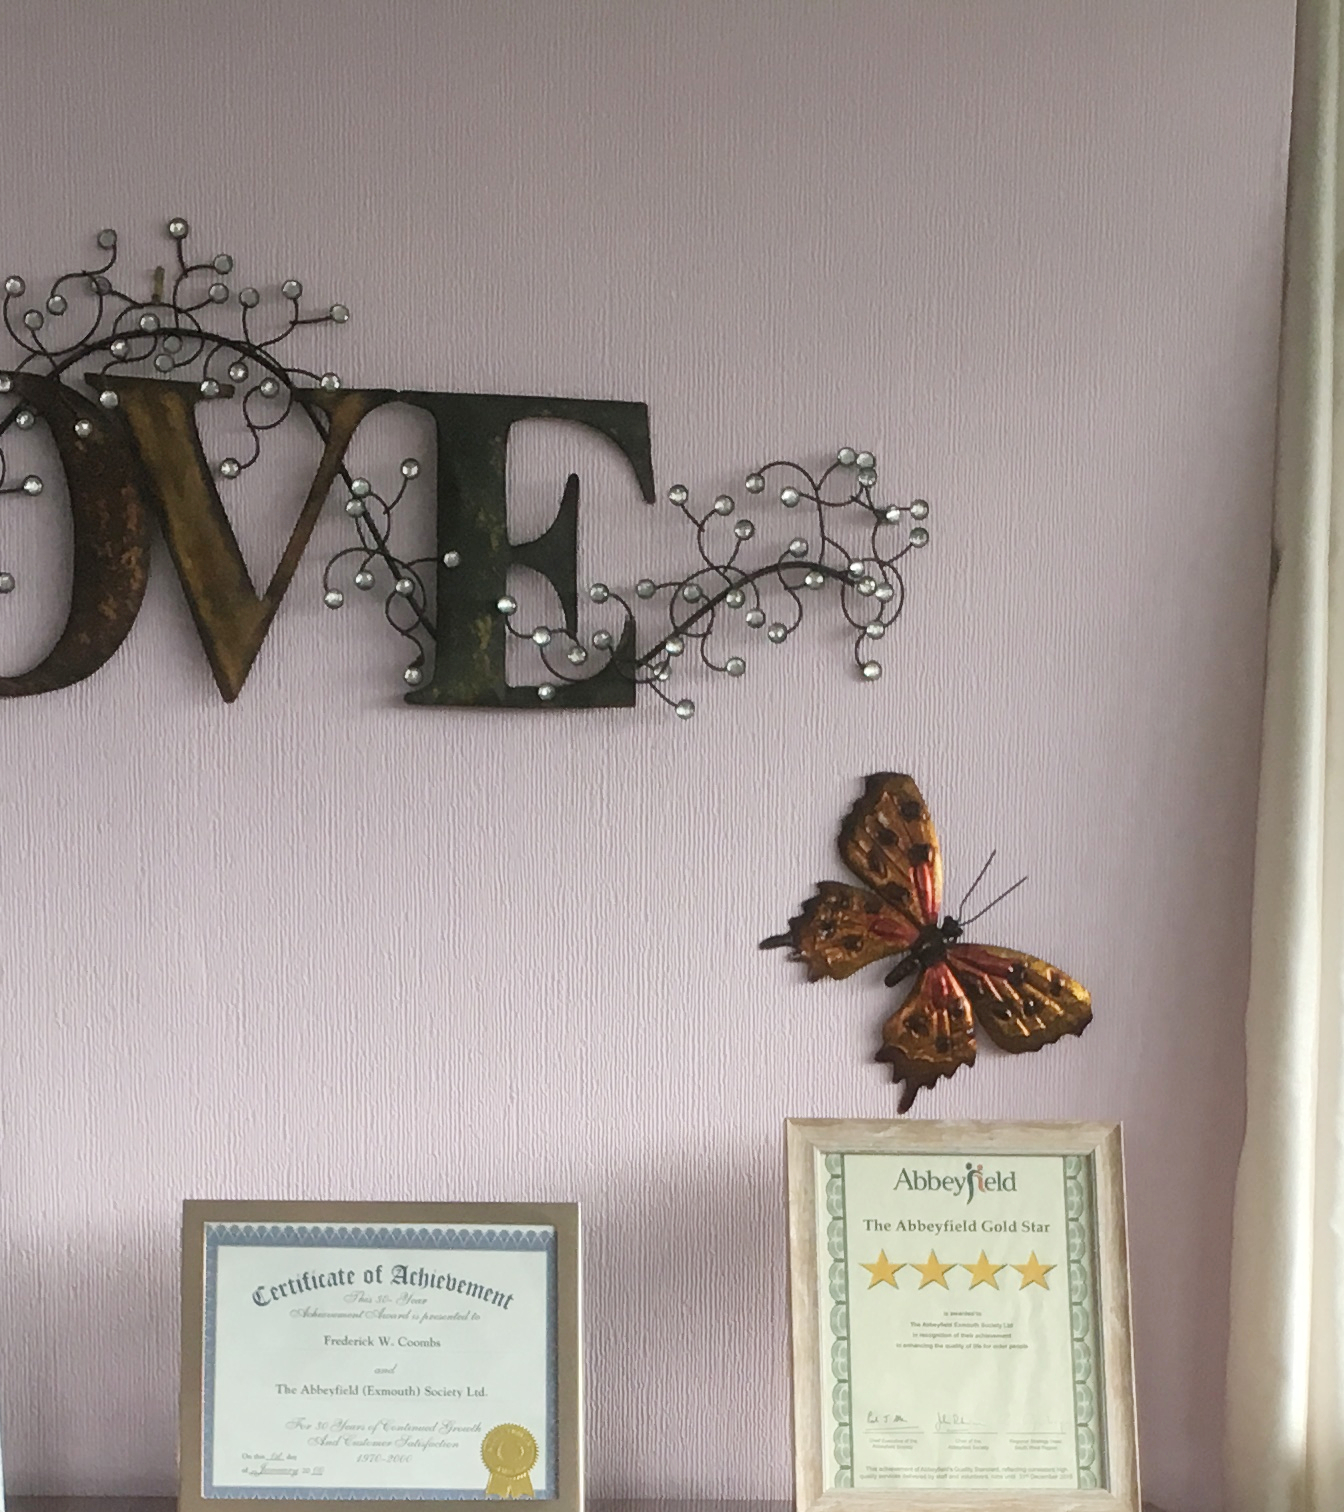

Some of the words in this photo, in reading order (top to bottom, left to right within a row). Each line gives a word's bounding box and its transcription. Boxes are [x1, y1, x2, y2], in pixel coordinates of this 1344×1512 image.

[893, 1162, 1018, 1206] Abbeyfield
[862, 1218, 892, 1232] The
[895, 1219, 978, 1236] Abbeyfield
[981, 1219, 1018, 1233] Gold
[1021, 1220, 1051, 1233] Star
[252, 1266, 356, 1307] Certificate
[362, 1264, 384, 1286] of
[390, 1264, 515, 1311] Achievement
[323, 1334, 375, 1347] Frederick
[378, 1336, 395, 1347] W.
[397, 1336, 442, 1348] Coombs
[373, 1363, 398, 1375] and
[275, 1383, 298, 1395] The
[300, 1383, 359, 1397] Abbeyfield
[362, 1385, 421, 1397] (Exmouth)
[424, 1385, 463, 1398] Society
[467, 1386, 489, 1398] Ltd.
